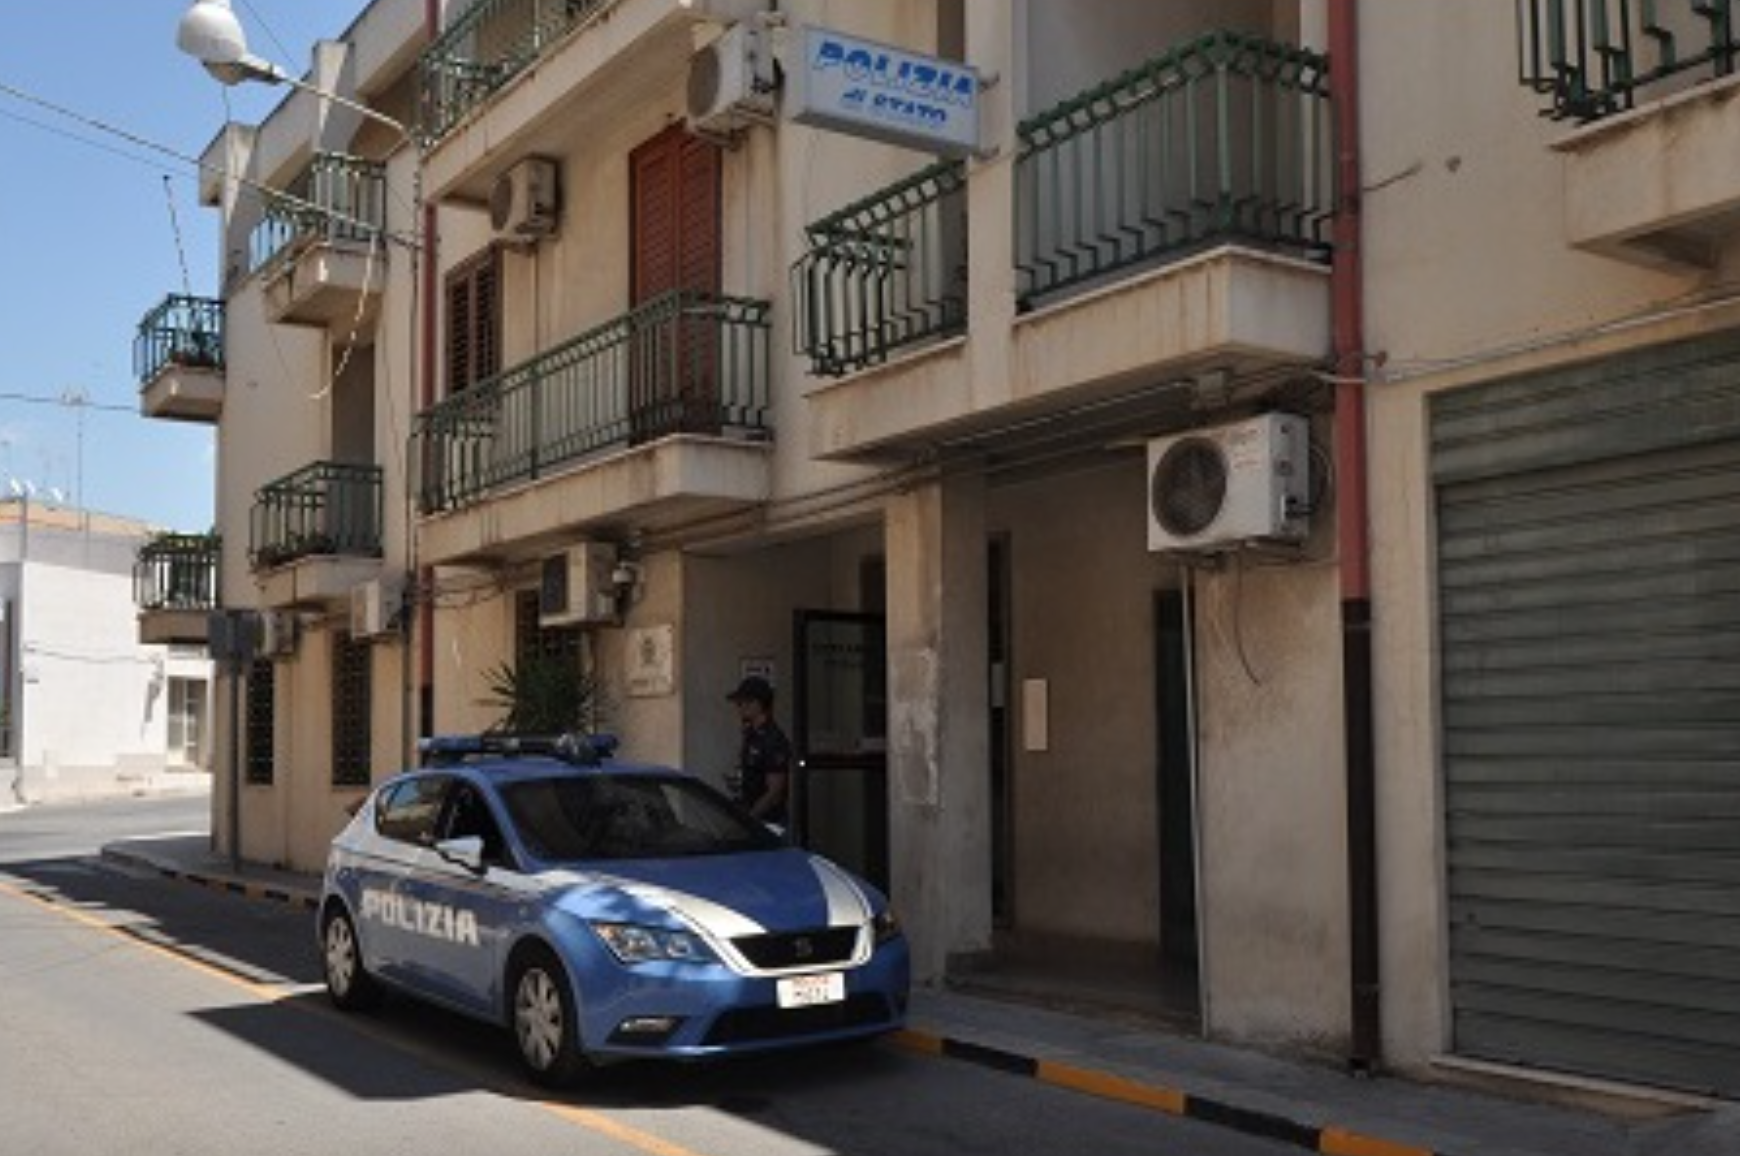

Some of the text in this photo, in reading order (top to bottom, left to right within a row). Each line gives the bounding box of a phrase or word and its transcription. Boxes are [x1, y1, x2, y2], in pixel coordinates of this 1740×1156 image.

[813, 41, 973, 108] POLIZIA
[870, 94, 947, 128] STATO
[361, 888, 479, 946] POLIZIA
